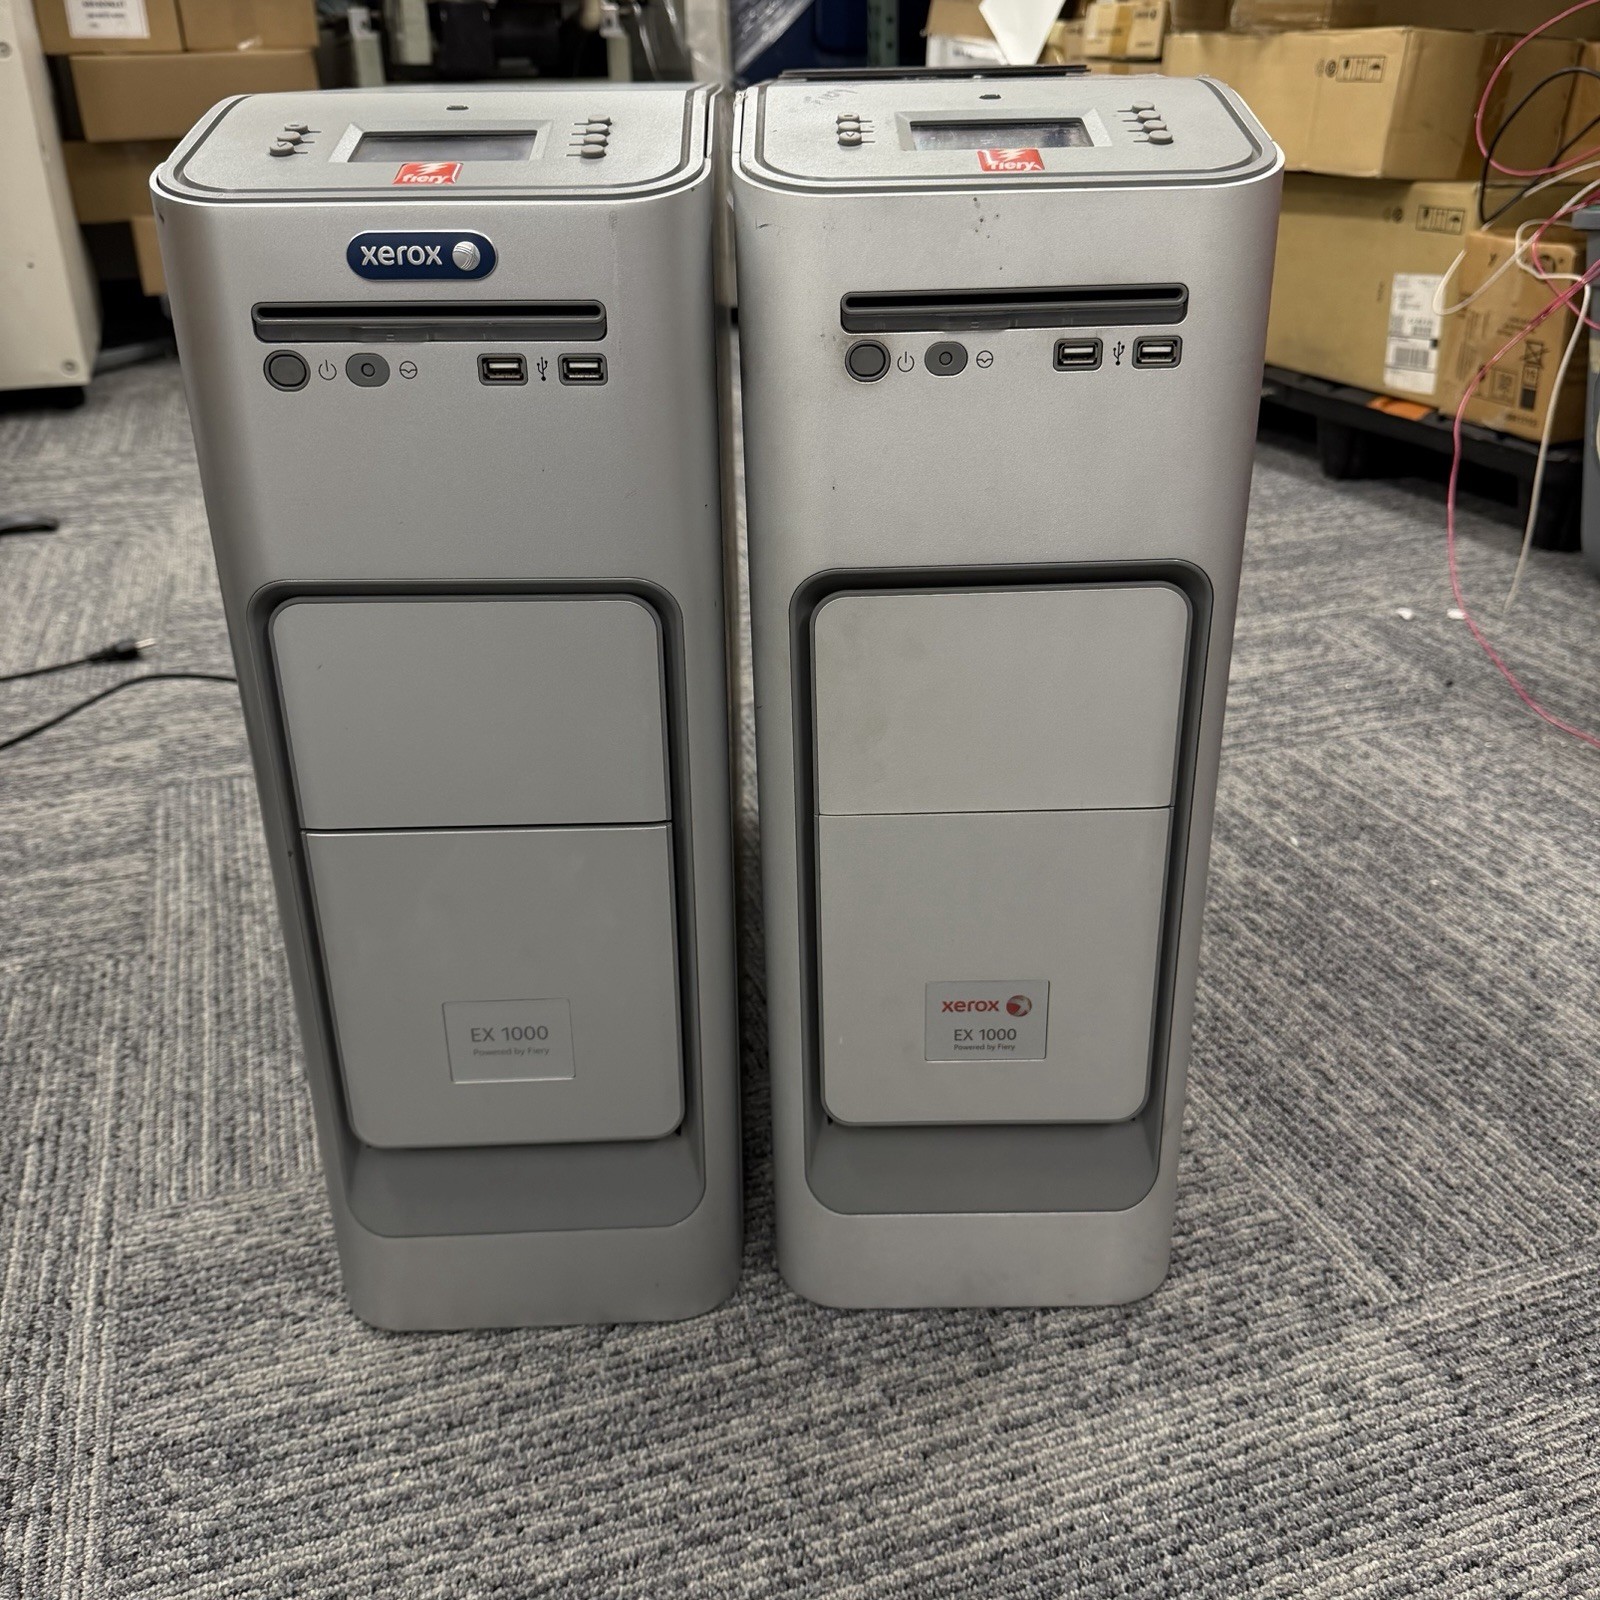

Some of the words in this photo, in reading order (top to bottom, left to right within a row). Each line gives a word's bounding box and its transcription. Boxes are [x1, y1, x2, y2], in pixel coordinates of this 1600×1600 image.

[360, 245, 443, 266] xerox
[942, 1000, 999, 1013] xerox
[470, 1027, 496, 1042] EX
[501, 1025, 549, 1041] 1000
[954, 1029, 973, 1041] EX
[979, 1028, 1017, 1041] 1000
[473, 1048, 512, 1056] Powered
[514, 1048, 524, 1056] by
[527, 1047, 550, 1056] Fiery
[953, 1043, 985, 1051] Powered
[987, 1043, 995, 1052] by
[997, 1043, 1016, 1051] Fiery
